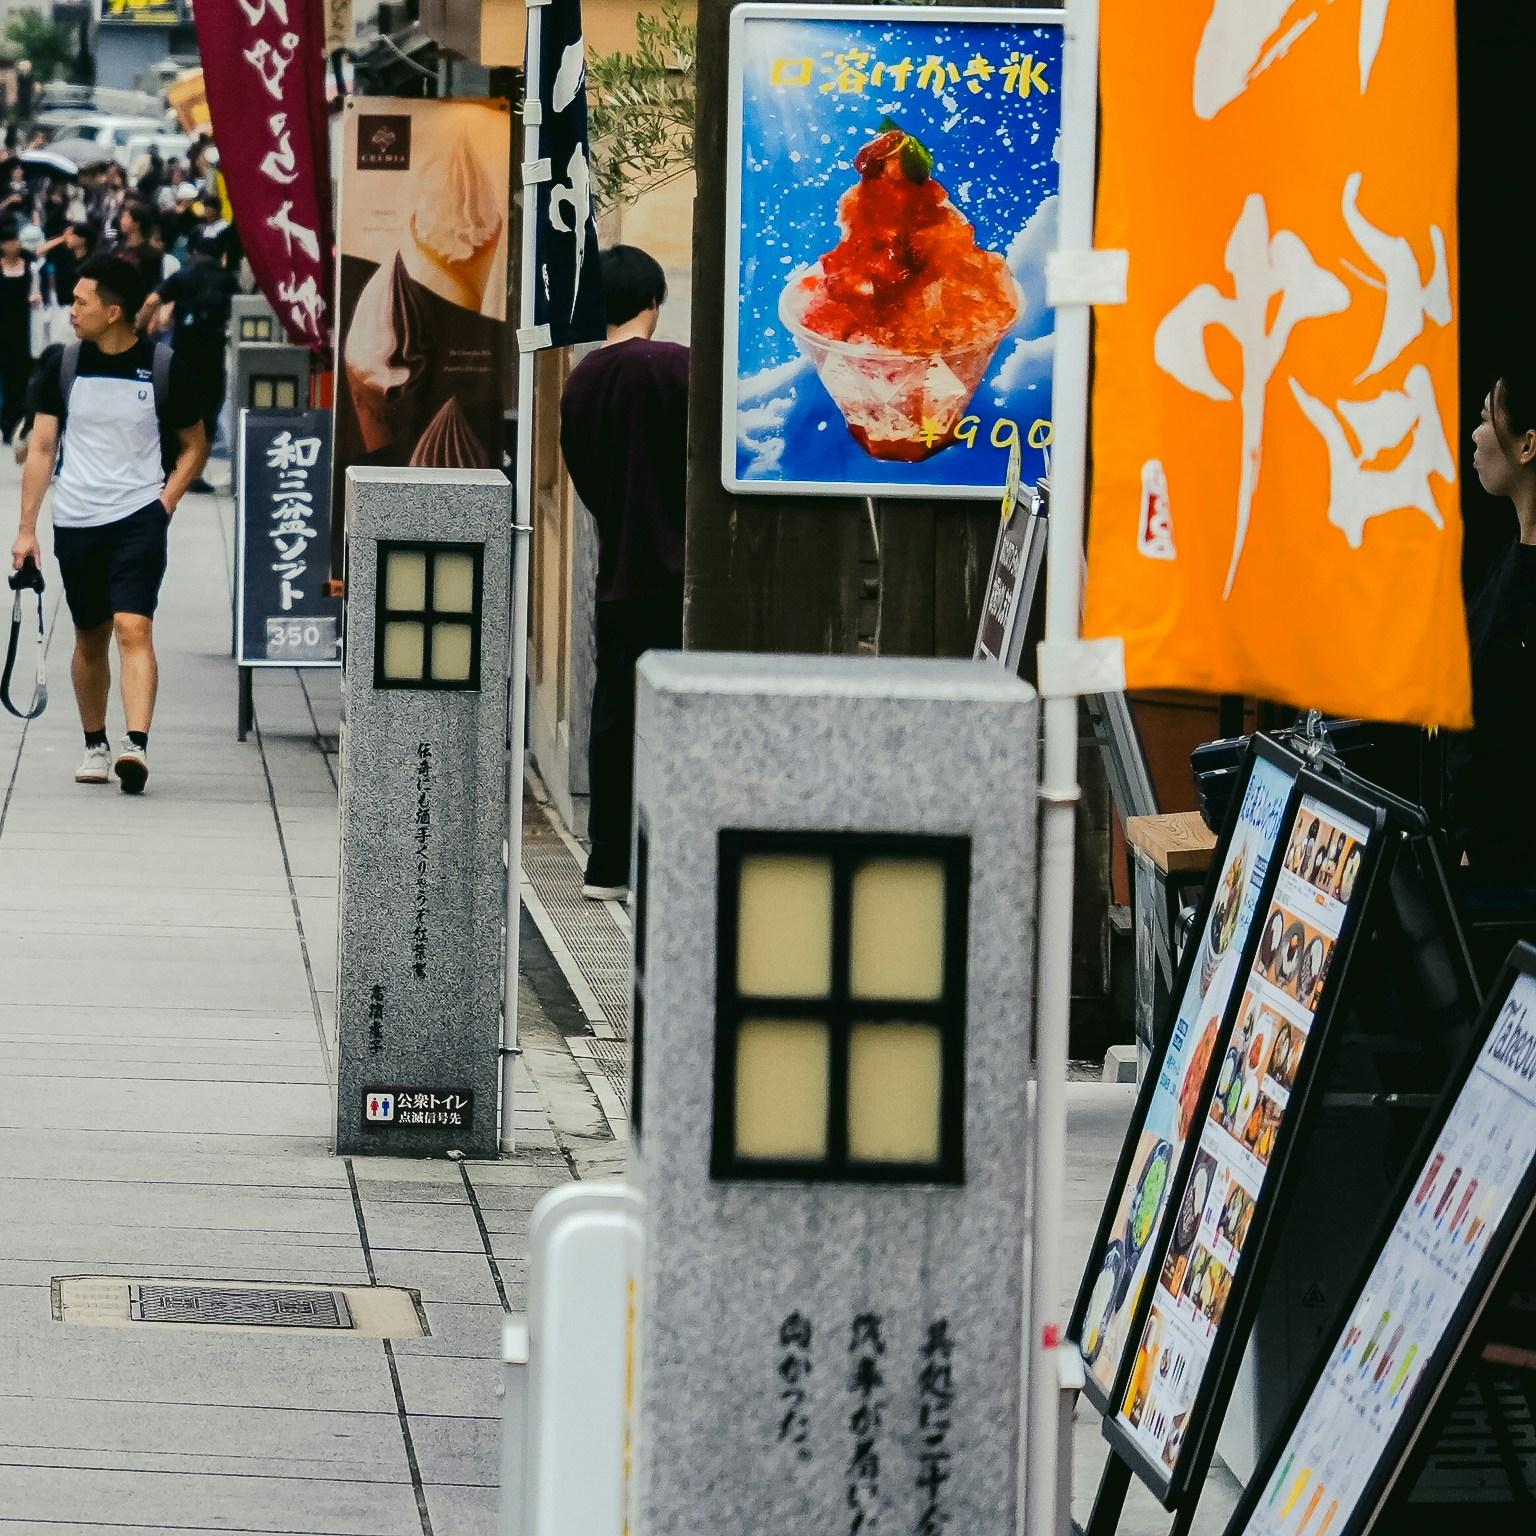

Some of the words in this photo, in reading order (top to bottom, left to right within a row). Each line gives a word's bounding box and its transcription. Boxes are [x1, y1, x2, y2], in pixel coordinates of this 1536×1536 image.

[770, 47, 1050, 99] 口溶けかき氷
[265, 430, 322, 611] 和三盆ソフト
[270, 625, 321, 646] 350
[397, 1092, 469, 1110] 公衆トイレ
[398, 1111, 462, 1124] 点滅信号先
